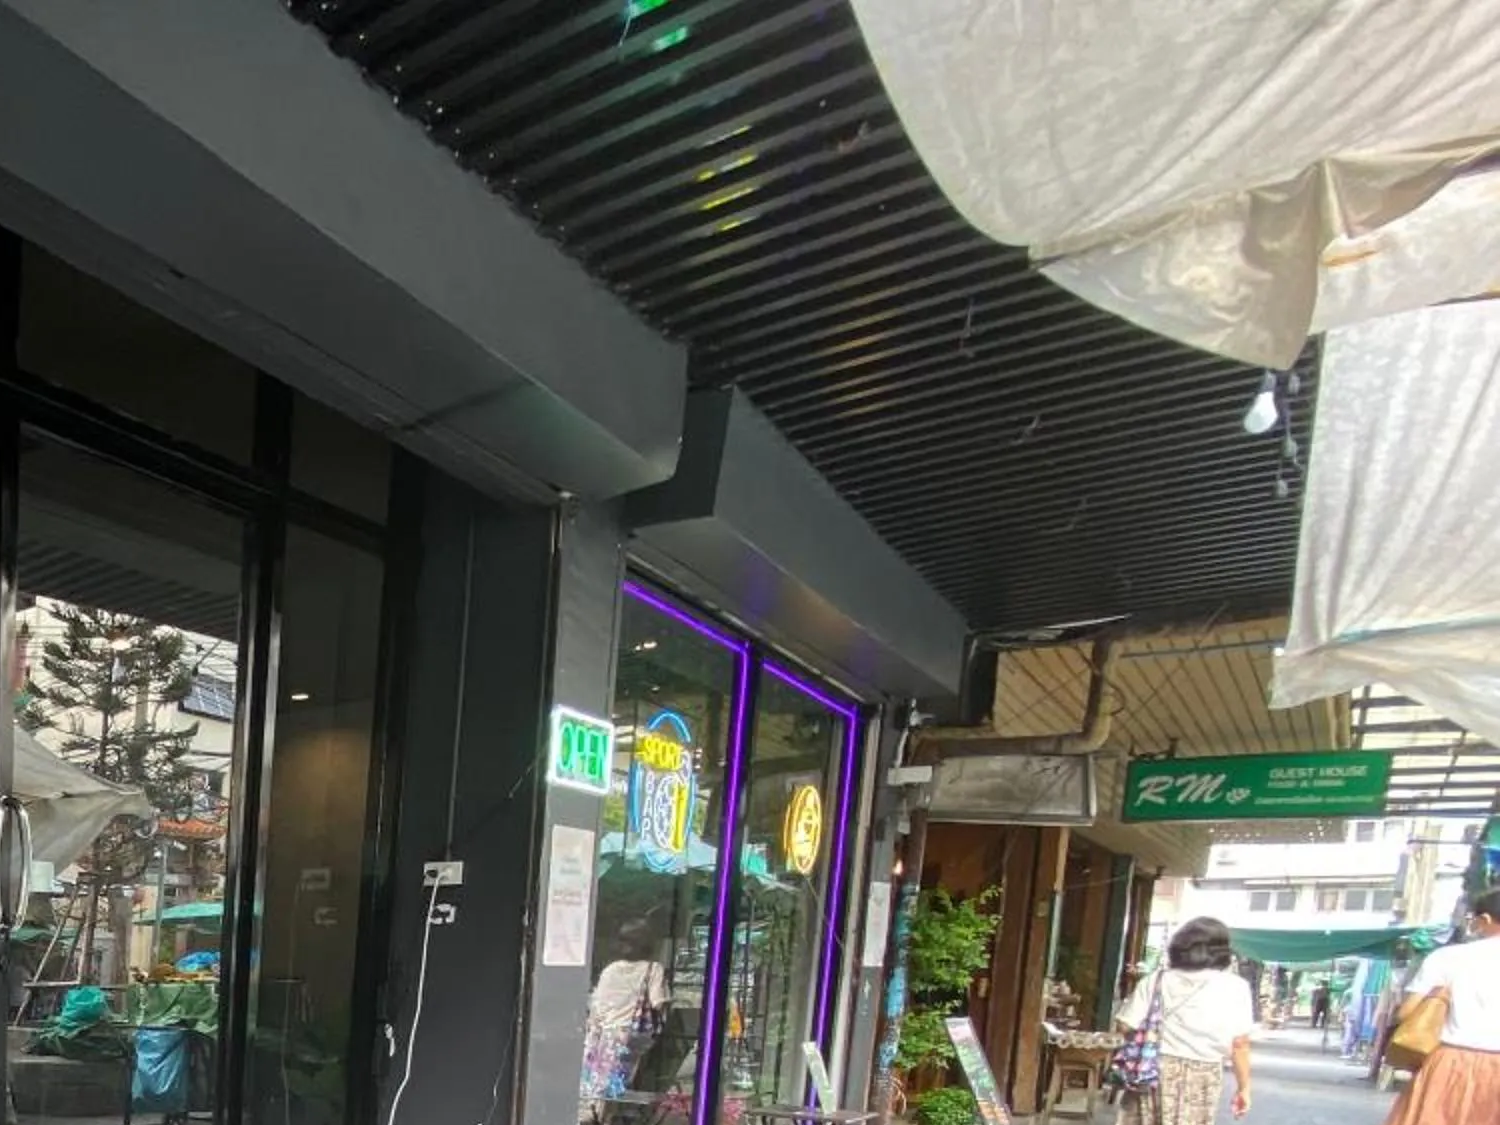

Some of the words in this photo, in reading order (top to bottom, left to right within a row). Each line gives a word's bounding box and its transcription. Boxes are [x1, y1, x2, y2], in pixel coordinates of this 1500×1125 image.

[560, 721, 610, 782] OPEN
[1269, 766, 1315, 779] GUEST
[1318, 765, 1368, 777] HOUSE
[1134, 773, 1226, 806] RM
